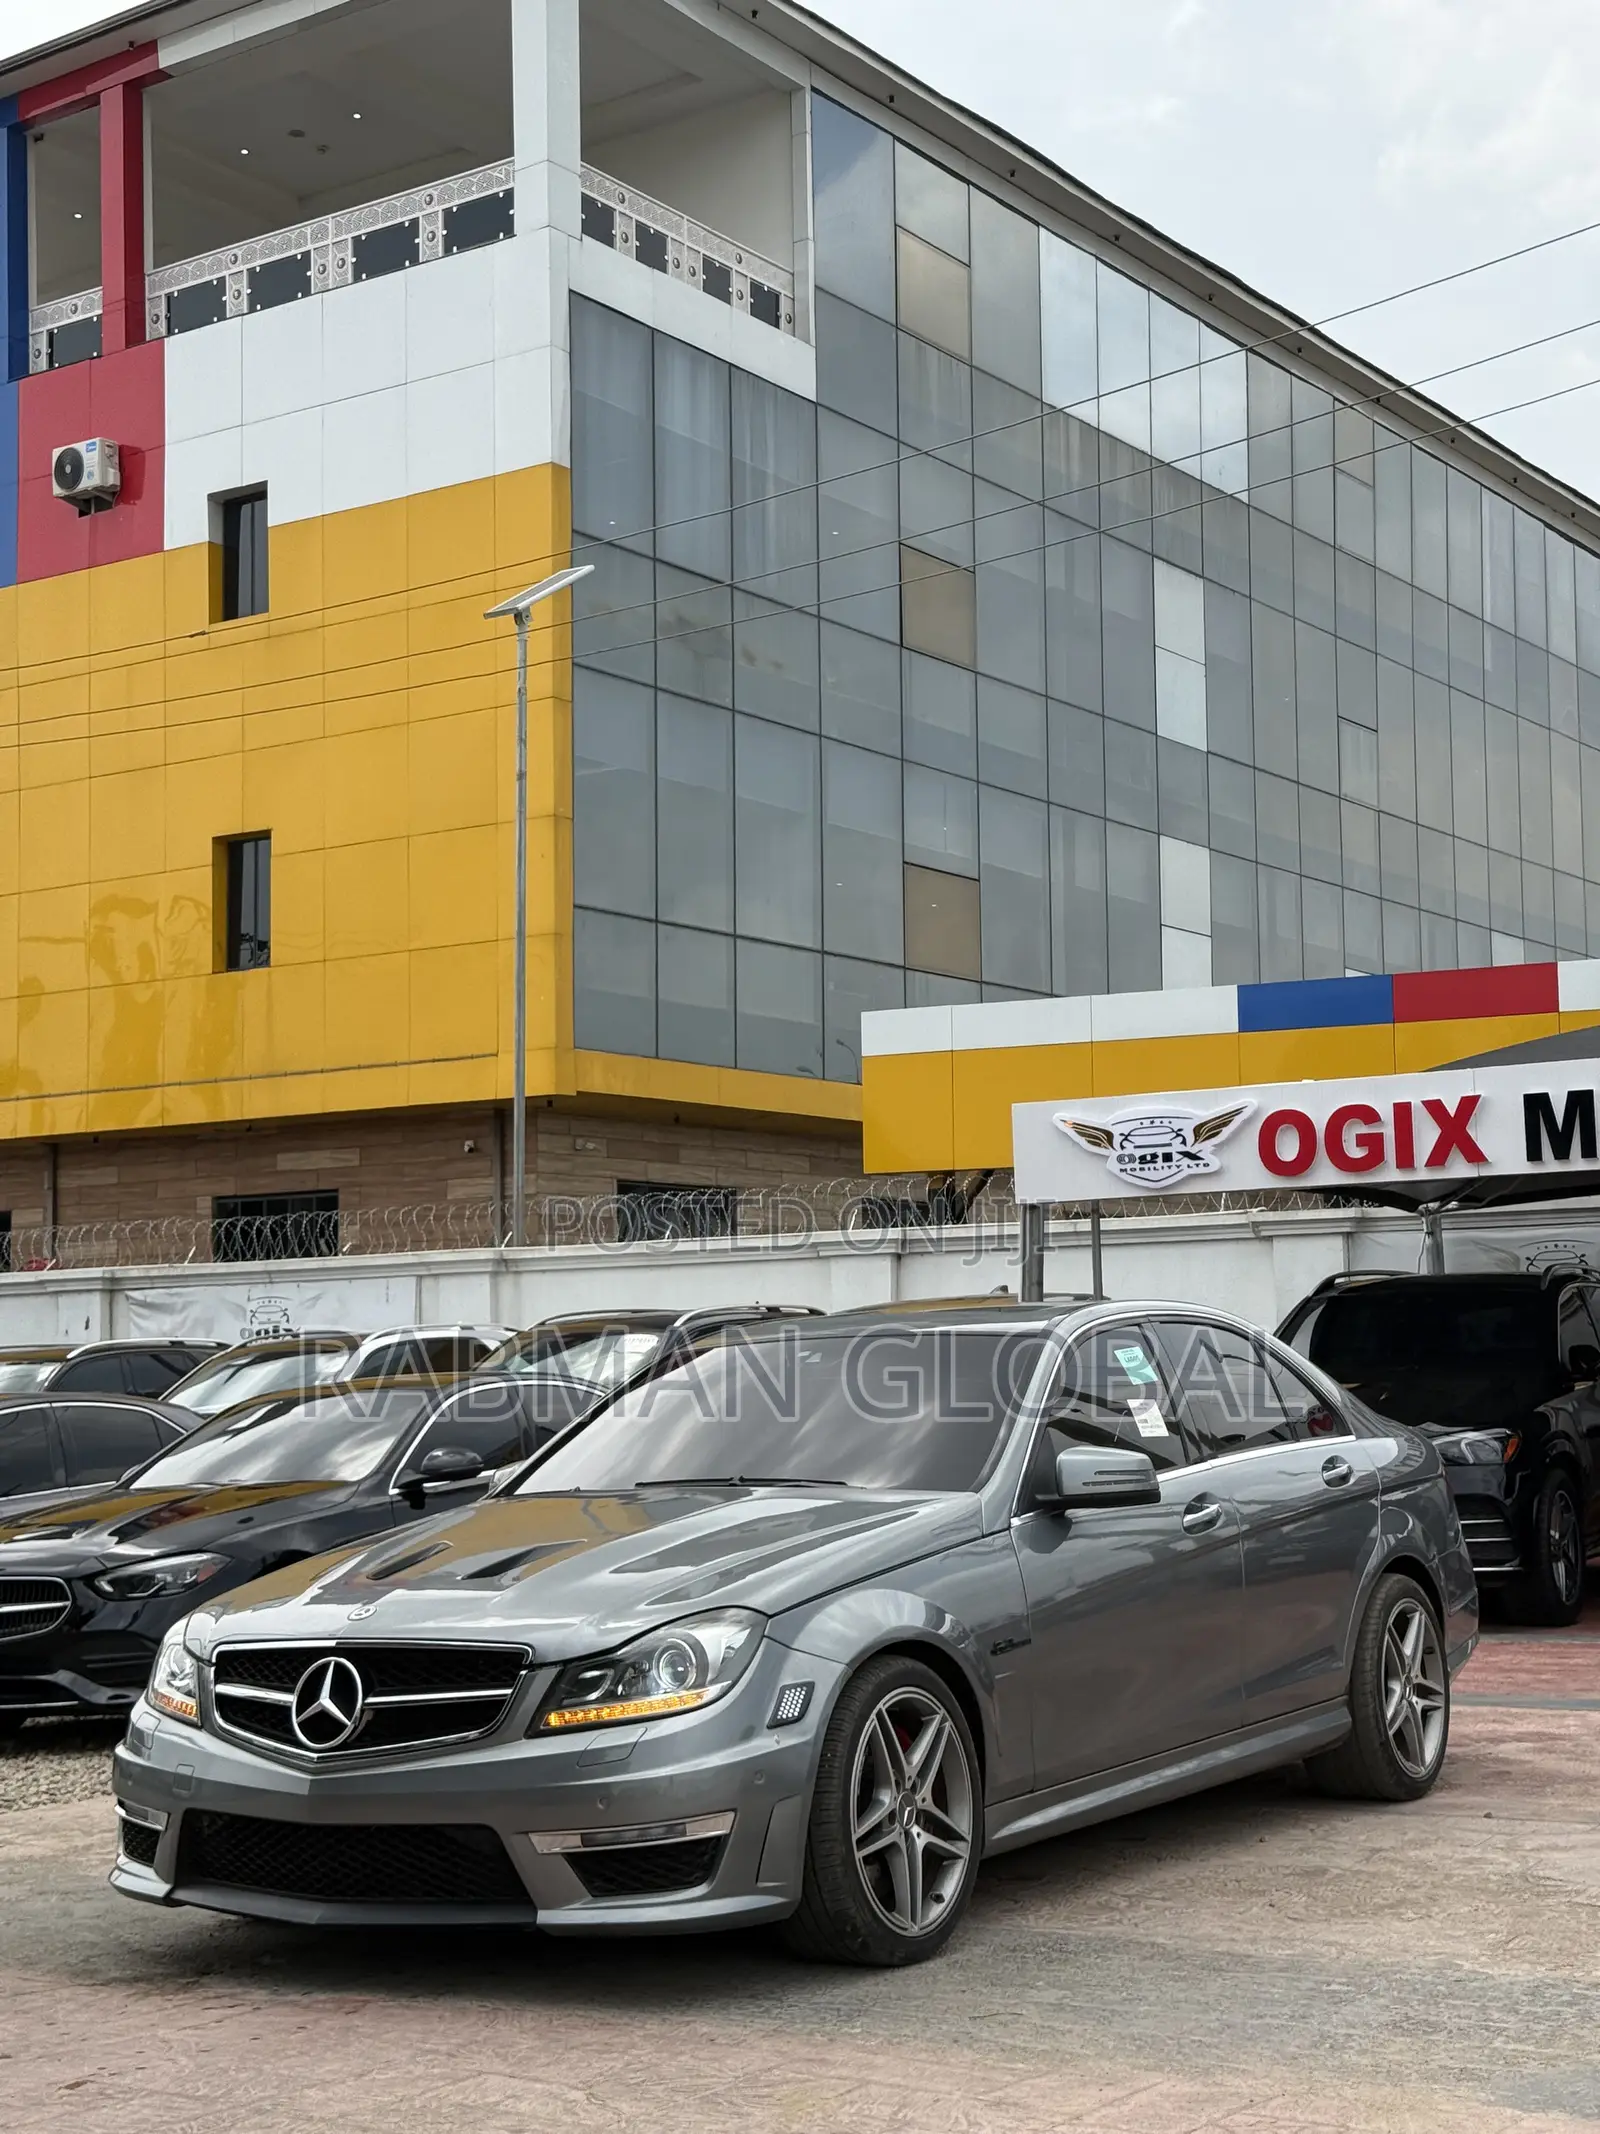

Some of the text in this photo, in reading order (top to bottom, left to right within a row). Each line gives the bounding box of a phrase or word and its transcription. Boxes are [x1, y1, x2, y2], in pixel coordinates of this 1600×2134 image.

[1257, 1089, 1598, 1177] OGIX M
[1119, 1163, 1183, 1173] MOBILITY
